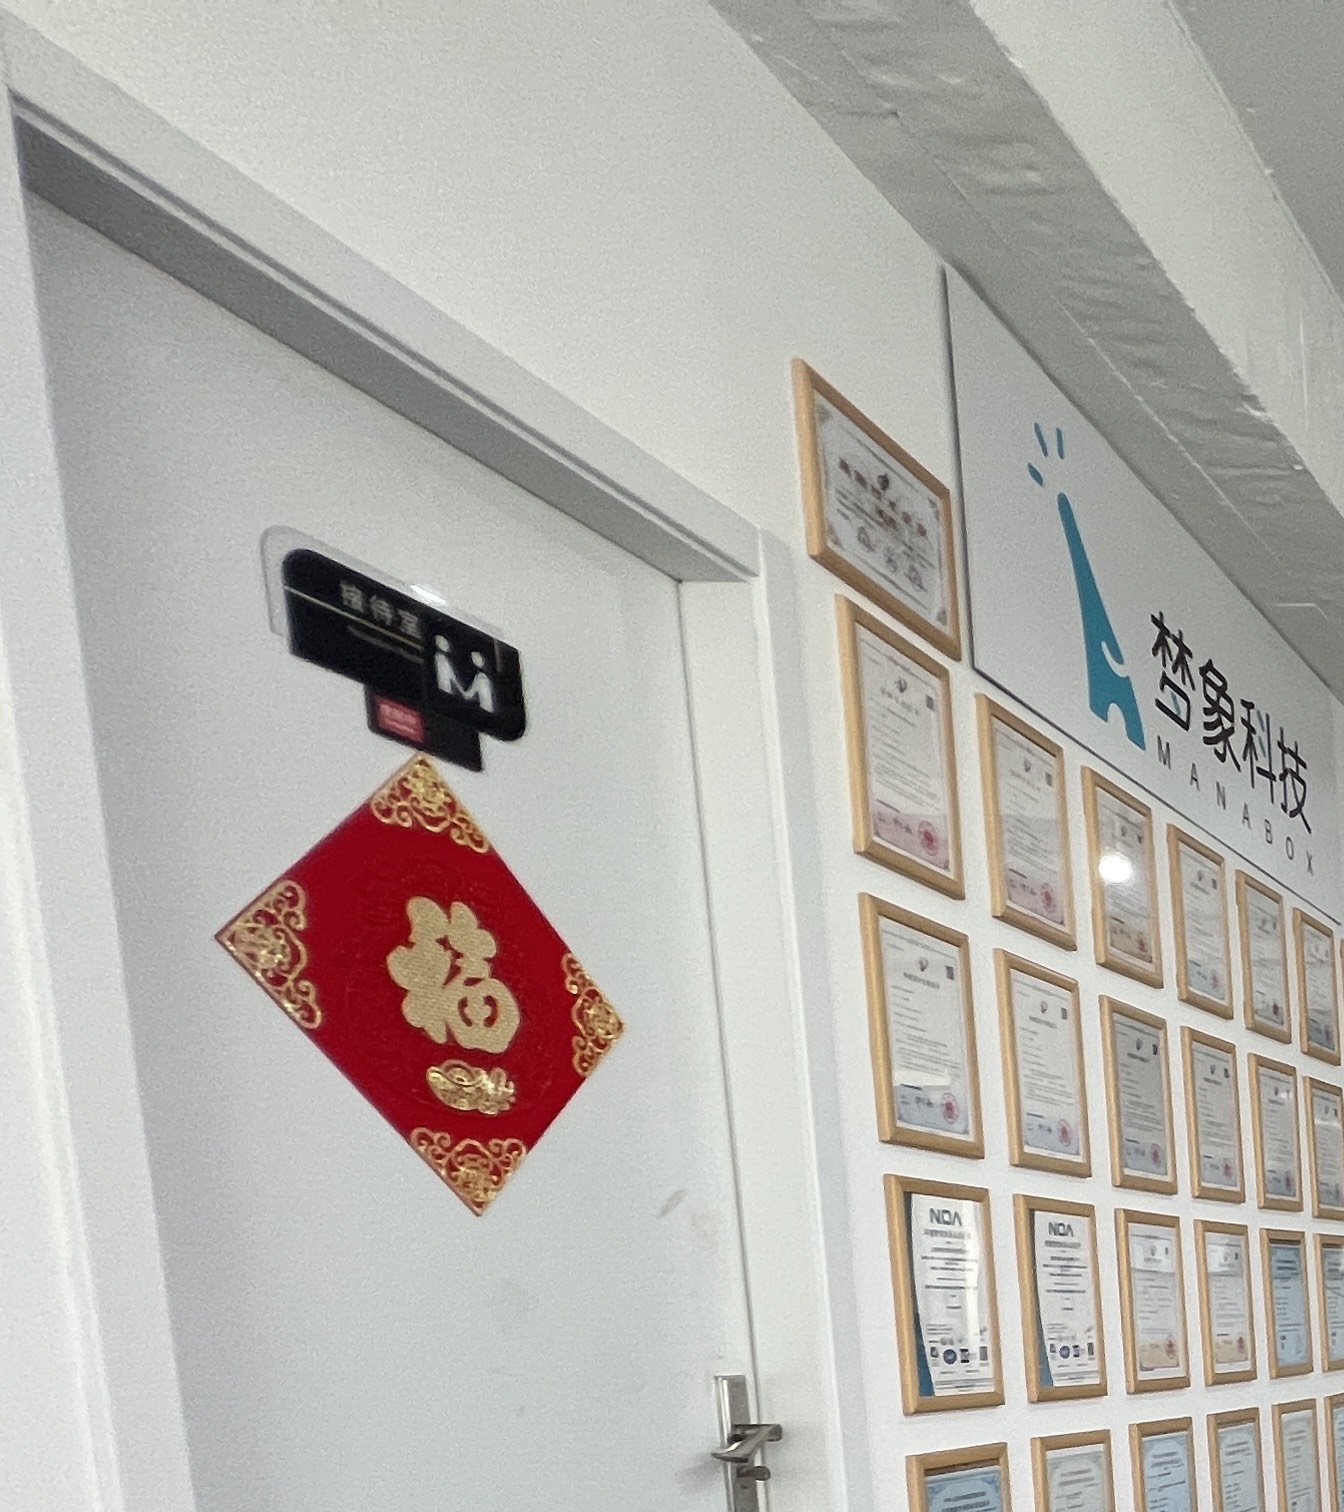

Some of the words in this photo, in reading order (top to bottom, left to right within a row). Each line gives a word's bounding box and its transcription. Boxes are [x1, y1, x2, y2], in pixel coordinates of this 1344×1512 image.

[1151, 611, 1312, 834] 梦象科技
[1156, 735, 1314, 877] MANABOX
[386, 896, 522, 1054] 福
